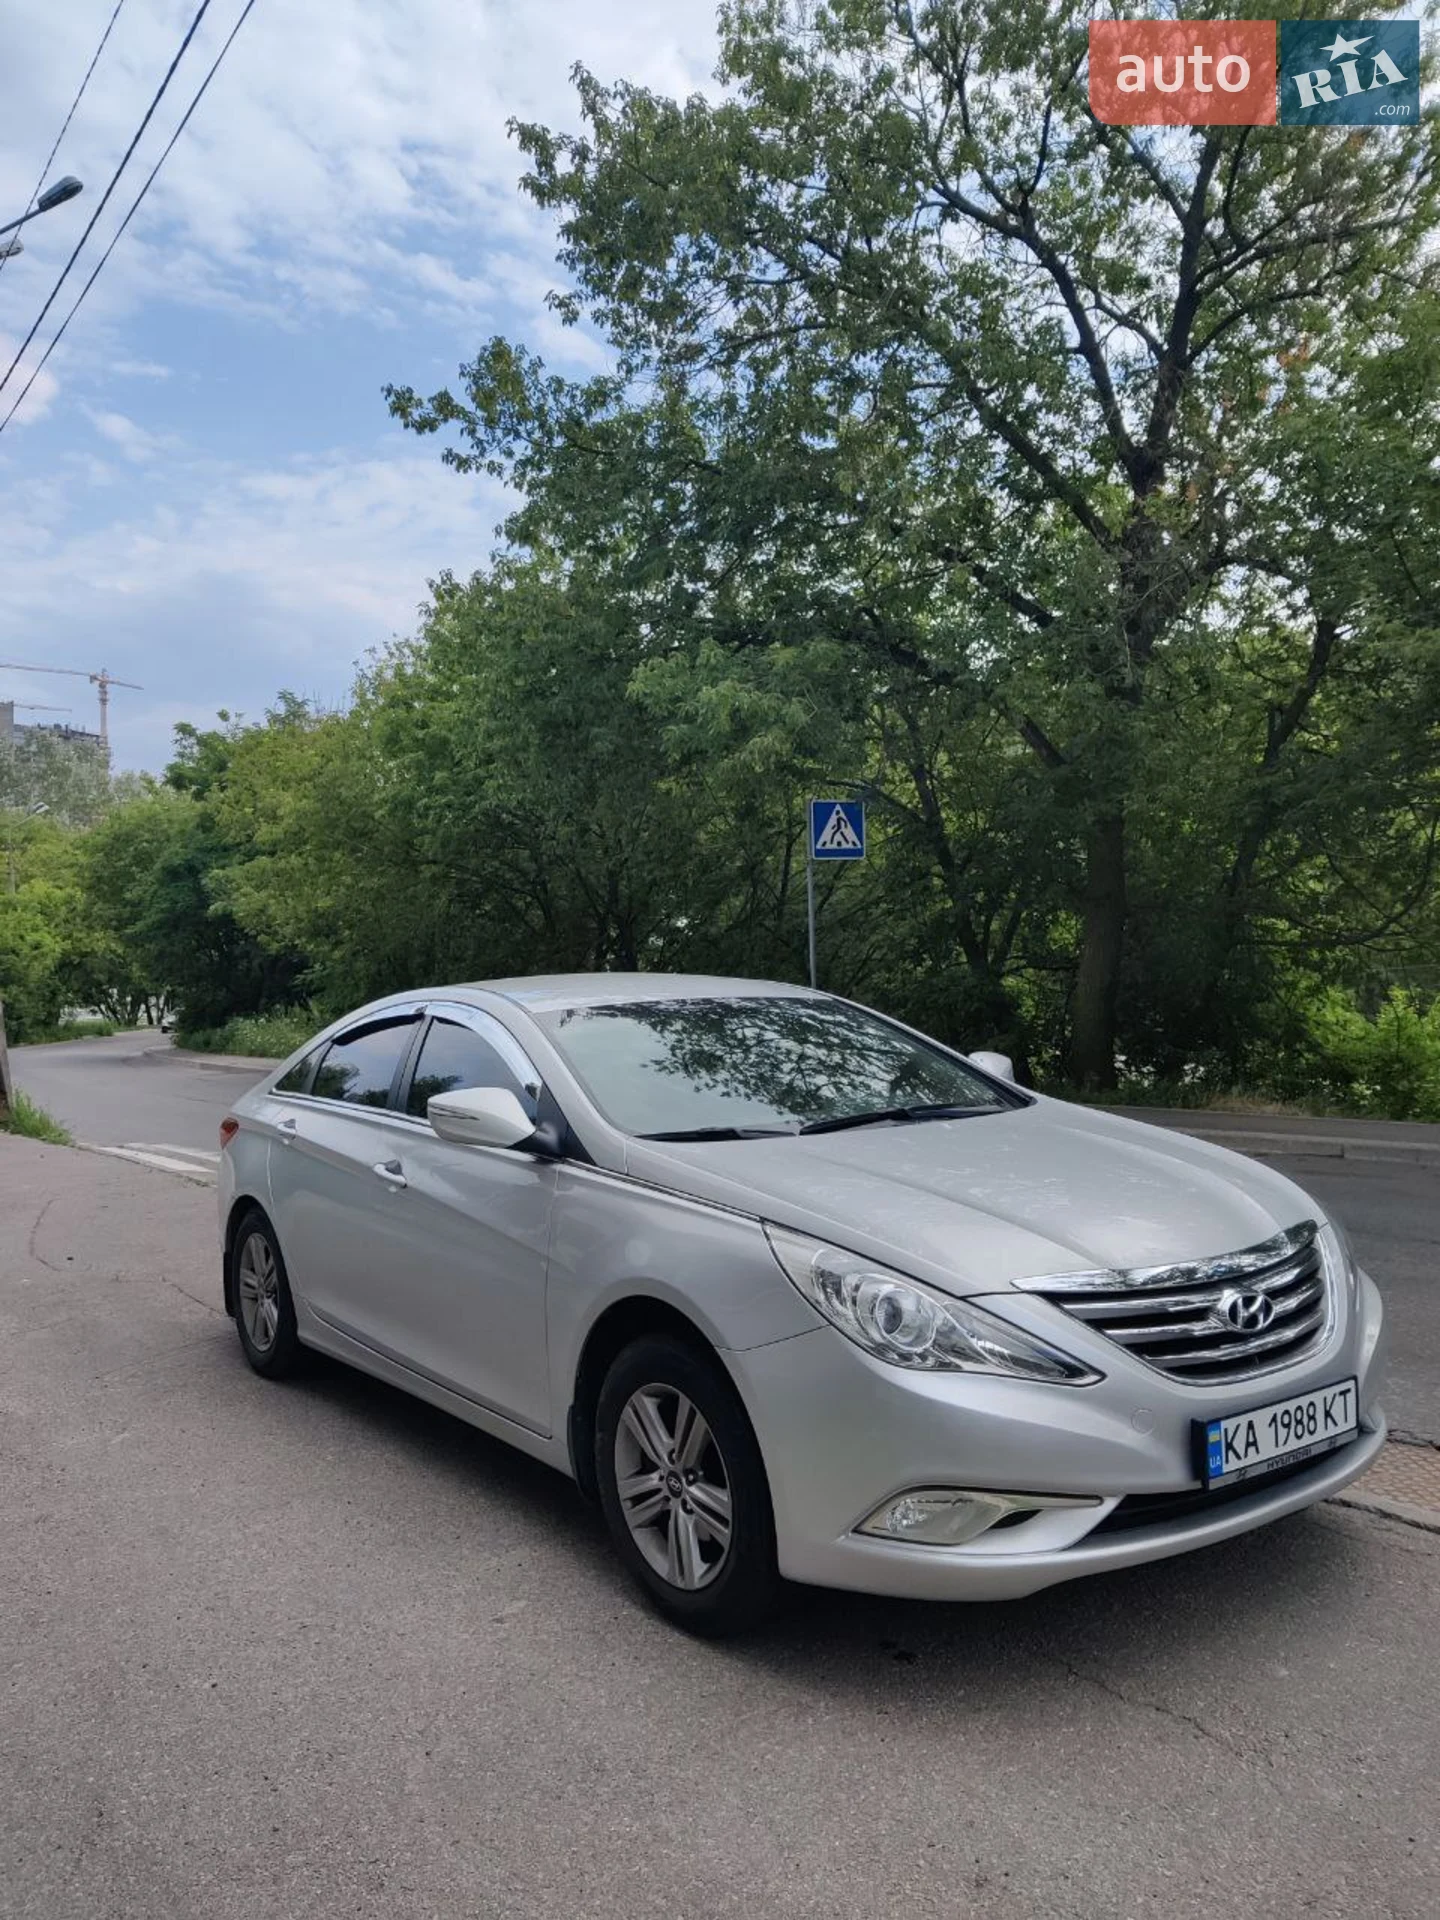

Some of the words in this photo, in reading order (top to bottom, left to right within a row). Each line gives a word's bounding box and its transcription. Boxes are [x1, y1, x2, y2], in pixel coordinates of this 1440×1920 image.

[1224, 1420, 1260, 1464] KA
[1268, 1401, 1317, 1448] 1988
[1323, 1388, 1352, 1430] KT
[1209, 1455, 1222, 1469] UA
